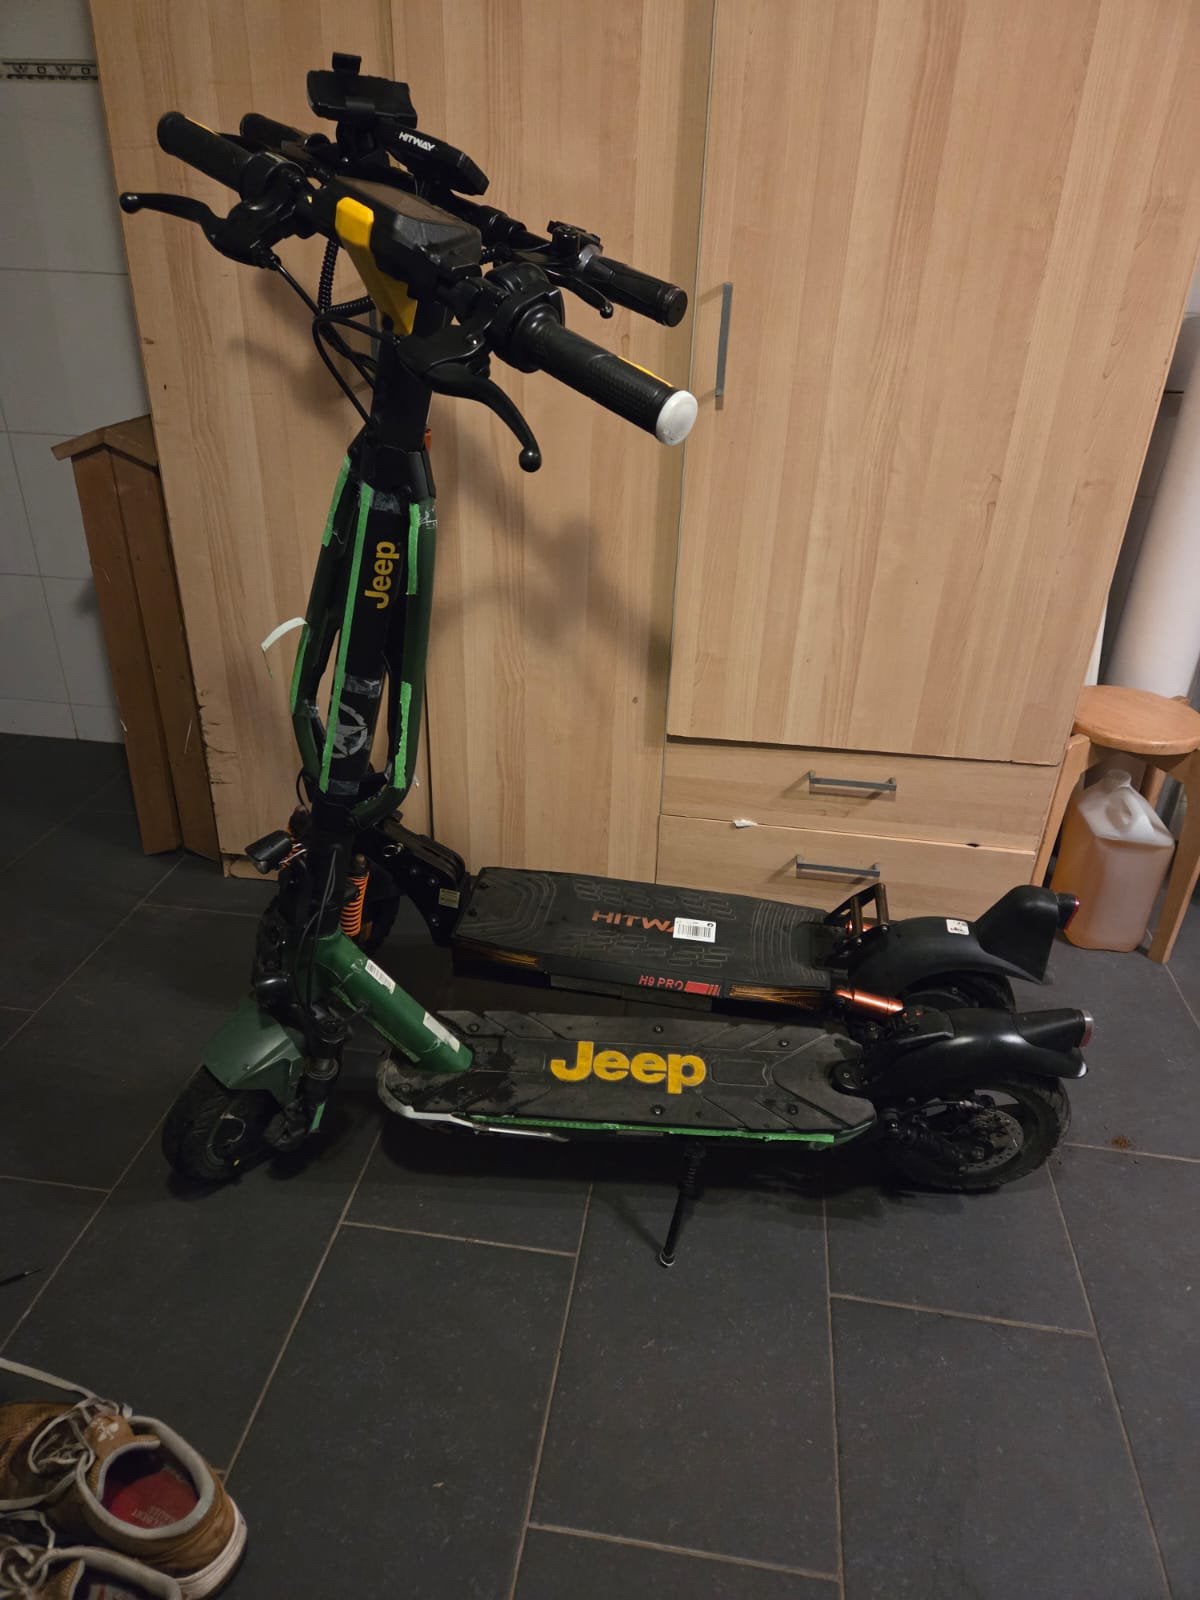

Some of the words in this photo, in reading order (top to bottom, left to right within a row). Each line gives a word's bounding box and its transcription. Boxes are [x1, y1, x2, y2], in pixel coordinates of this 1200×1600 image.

[398, 131, 436, 152] HITWAY
[364, 541, 400, 609] Jeep
[592, 911, 675, 933] HITW
[639, 975, 655, 987] H9
[656, 977, 684, 991] PRO
[550, 1040, 707, 1094] Jeep
